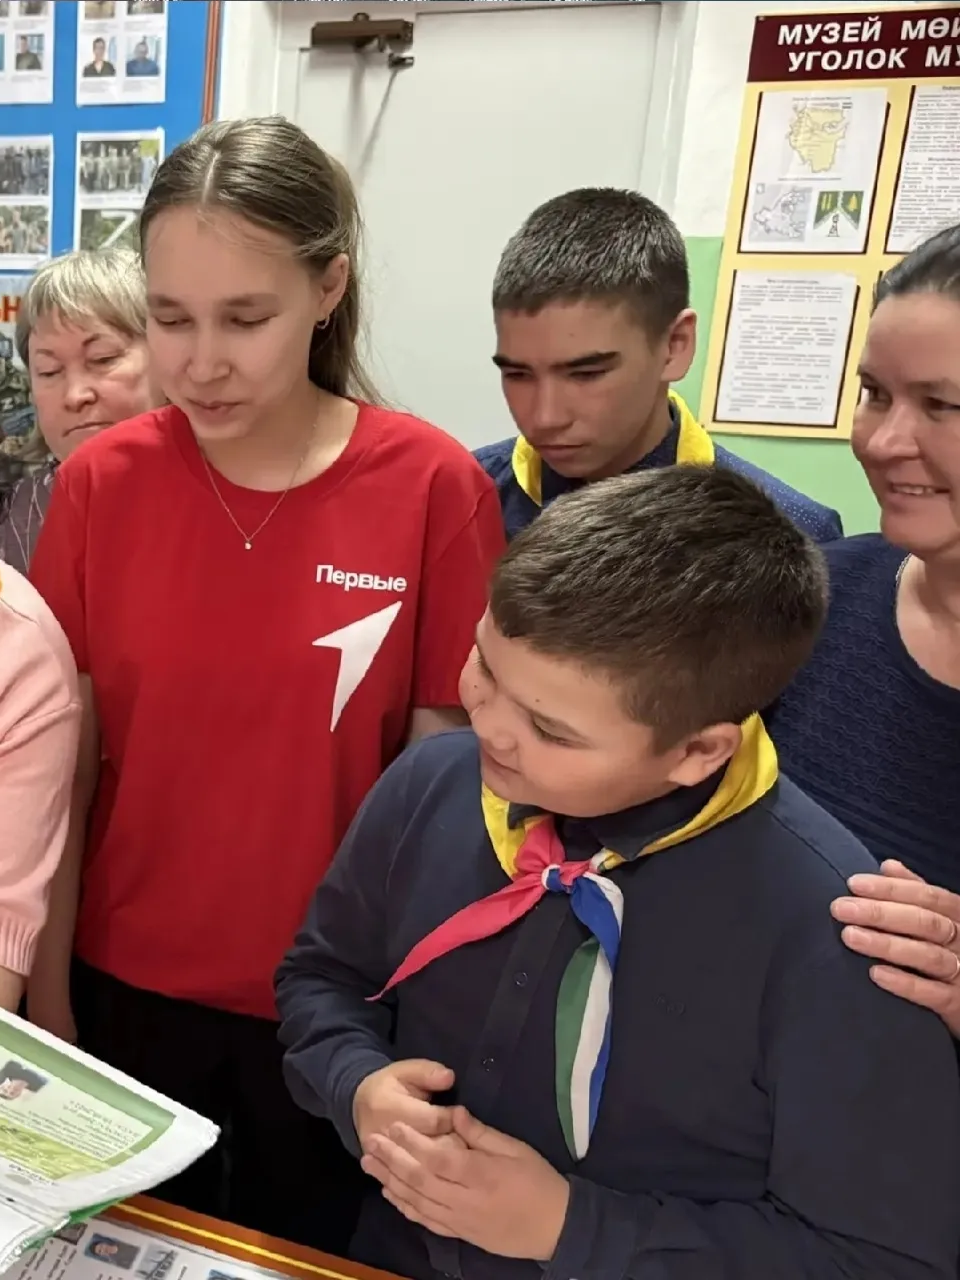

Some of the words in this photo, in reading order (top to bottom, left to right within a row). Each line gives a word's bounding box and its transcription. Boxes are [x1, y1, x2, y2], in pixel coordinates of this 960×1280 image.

[778, 16, 882, 45] МУЗЕЙ
[789, 47, 908, 72] УГОЛОК
[316, 565, 408, 592] Первые
